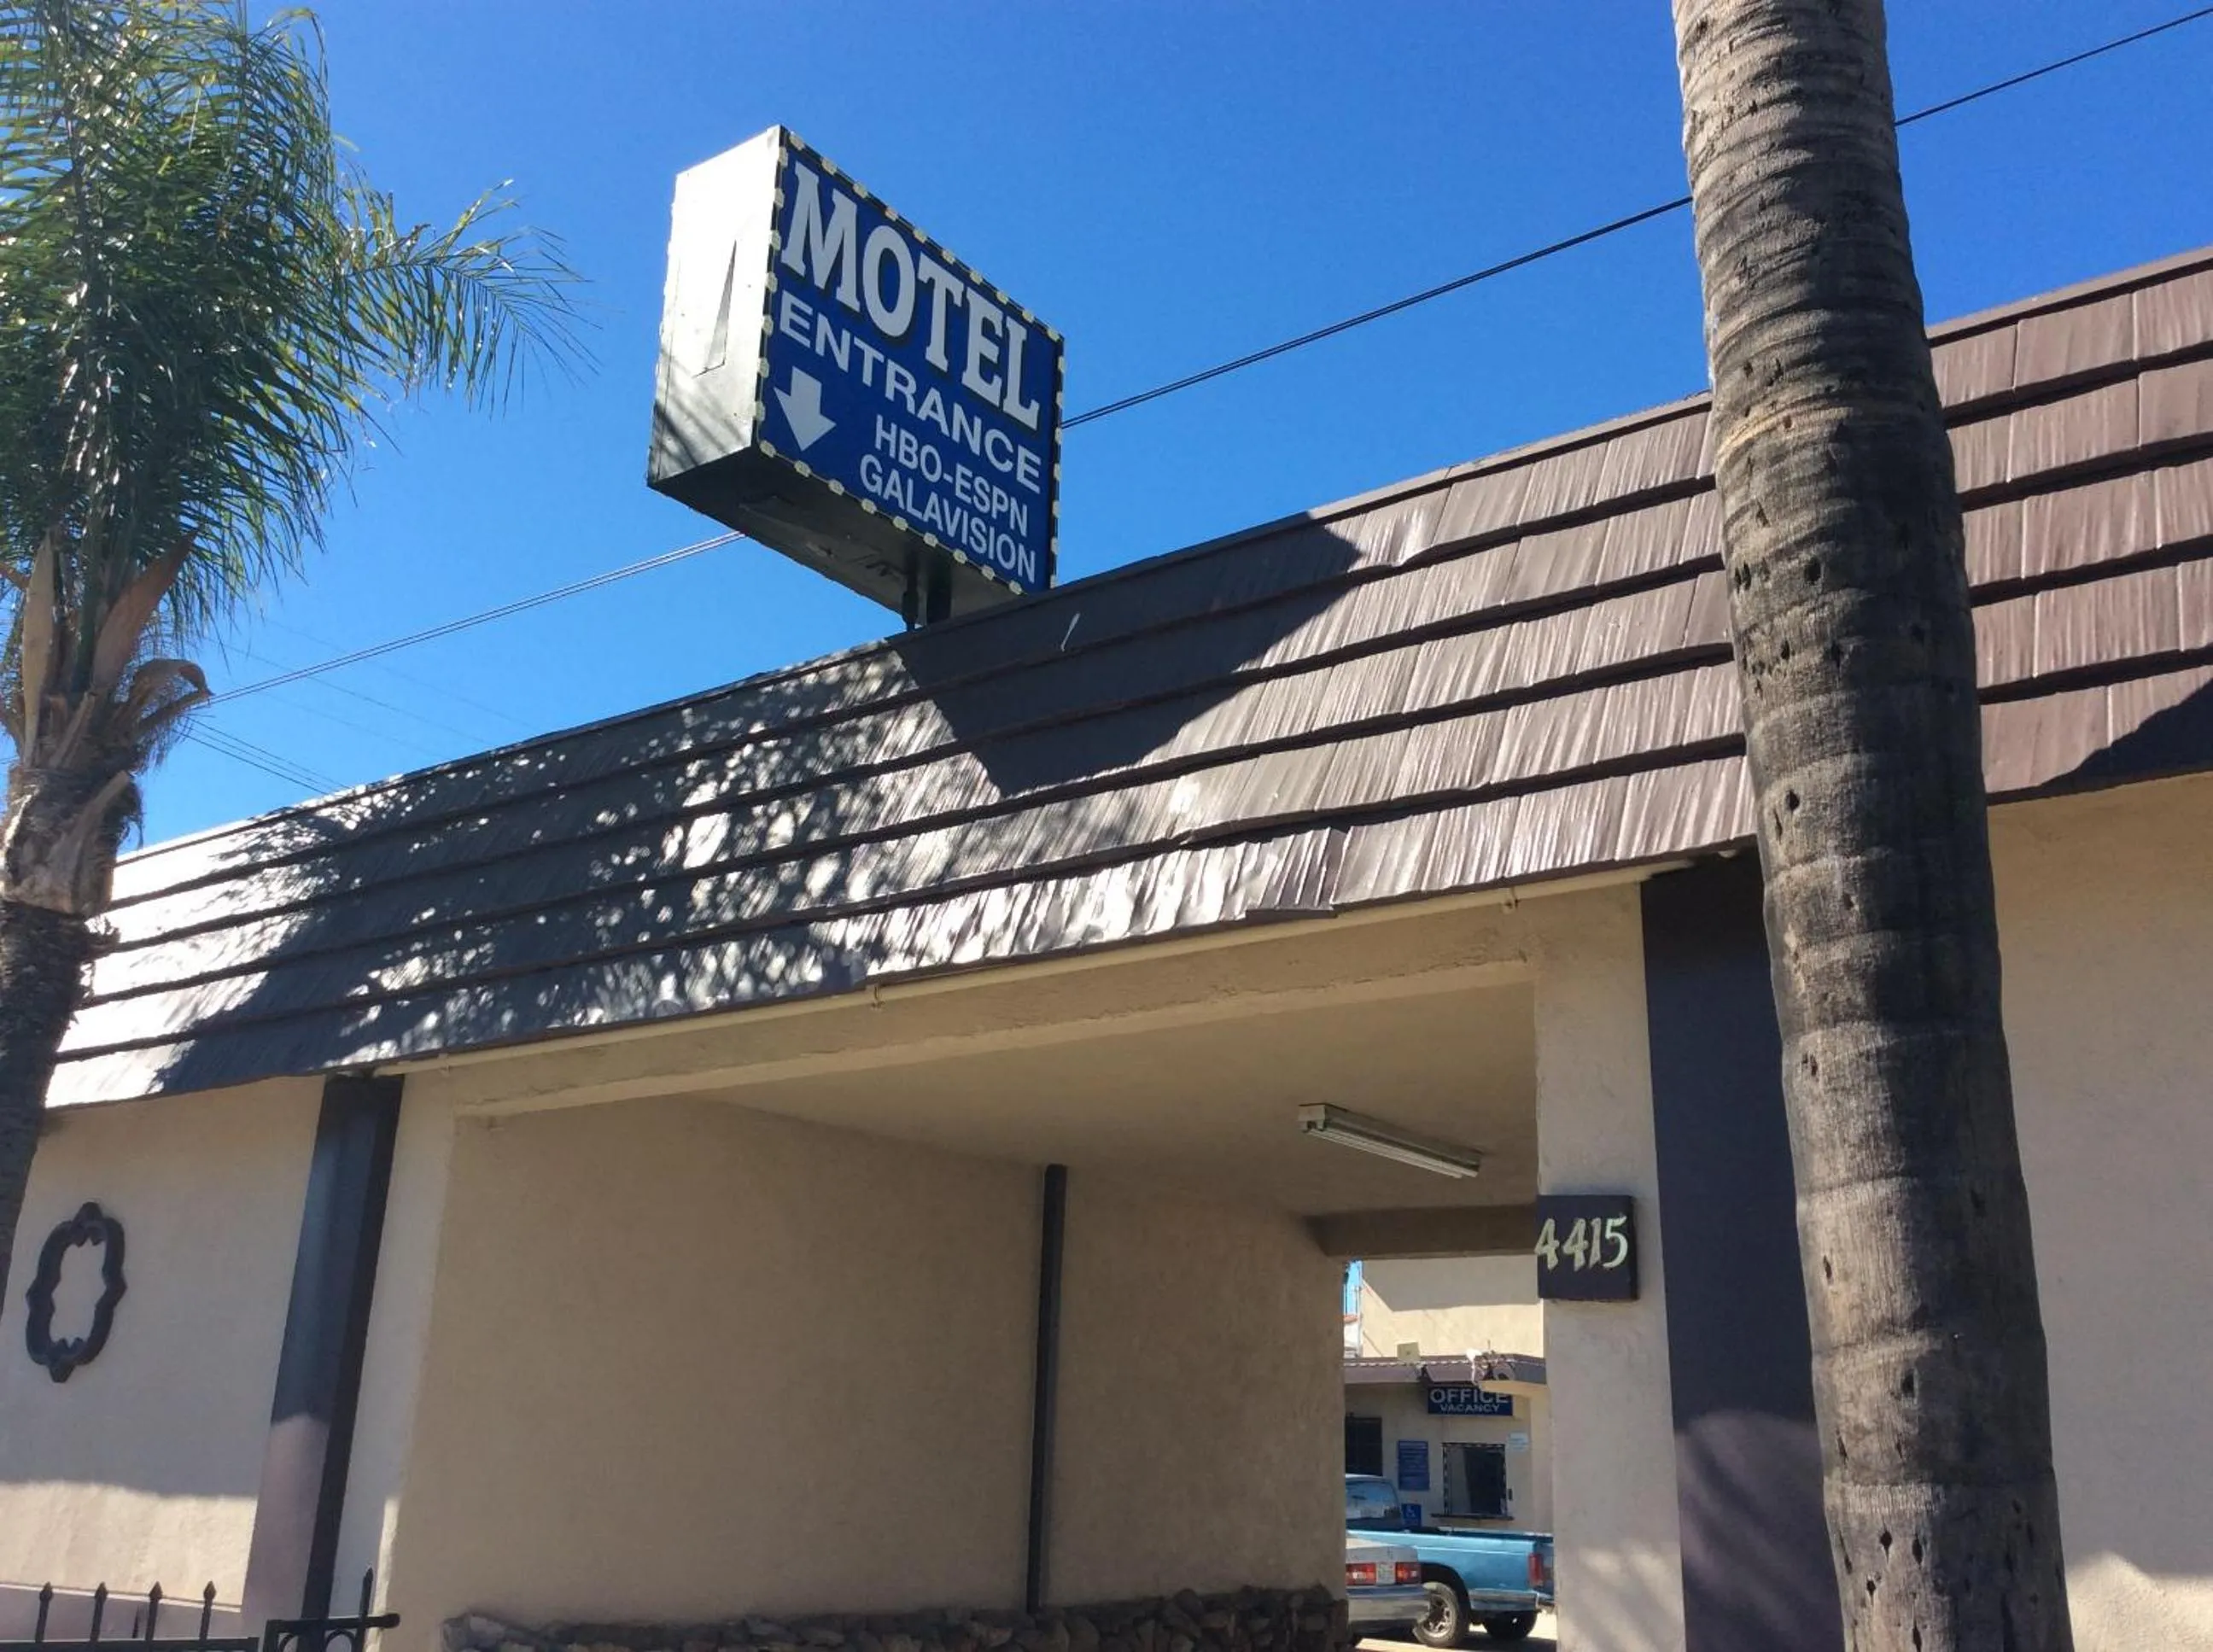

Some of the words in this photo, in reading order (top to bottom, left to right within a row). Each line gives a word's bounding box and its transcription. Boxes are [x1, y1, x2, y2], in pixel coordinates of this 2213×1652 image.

[780, 163, 1040, 429] MOTEL
[779, 289, 1041, 494] ENTRANCE
[860, 454, 1036, 584] GALAVISION
[875, 415, 1028, 538] HBO-ESPN
[1534, 1215, 1628, 1271] 4415
[1430, 1388, 1509, 1404] OFFICE
[1439, 1403, 1500, 1413] VACANCY
